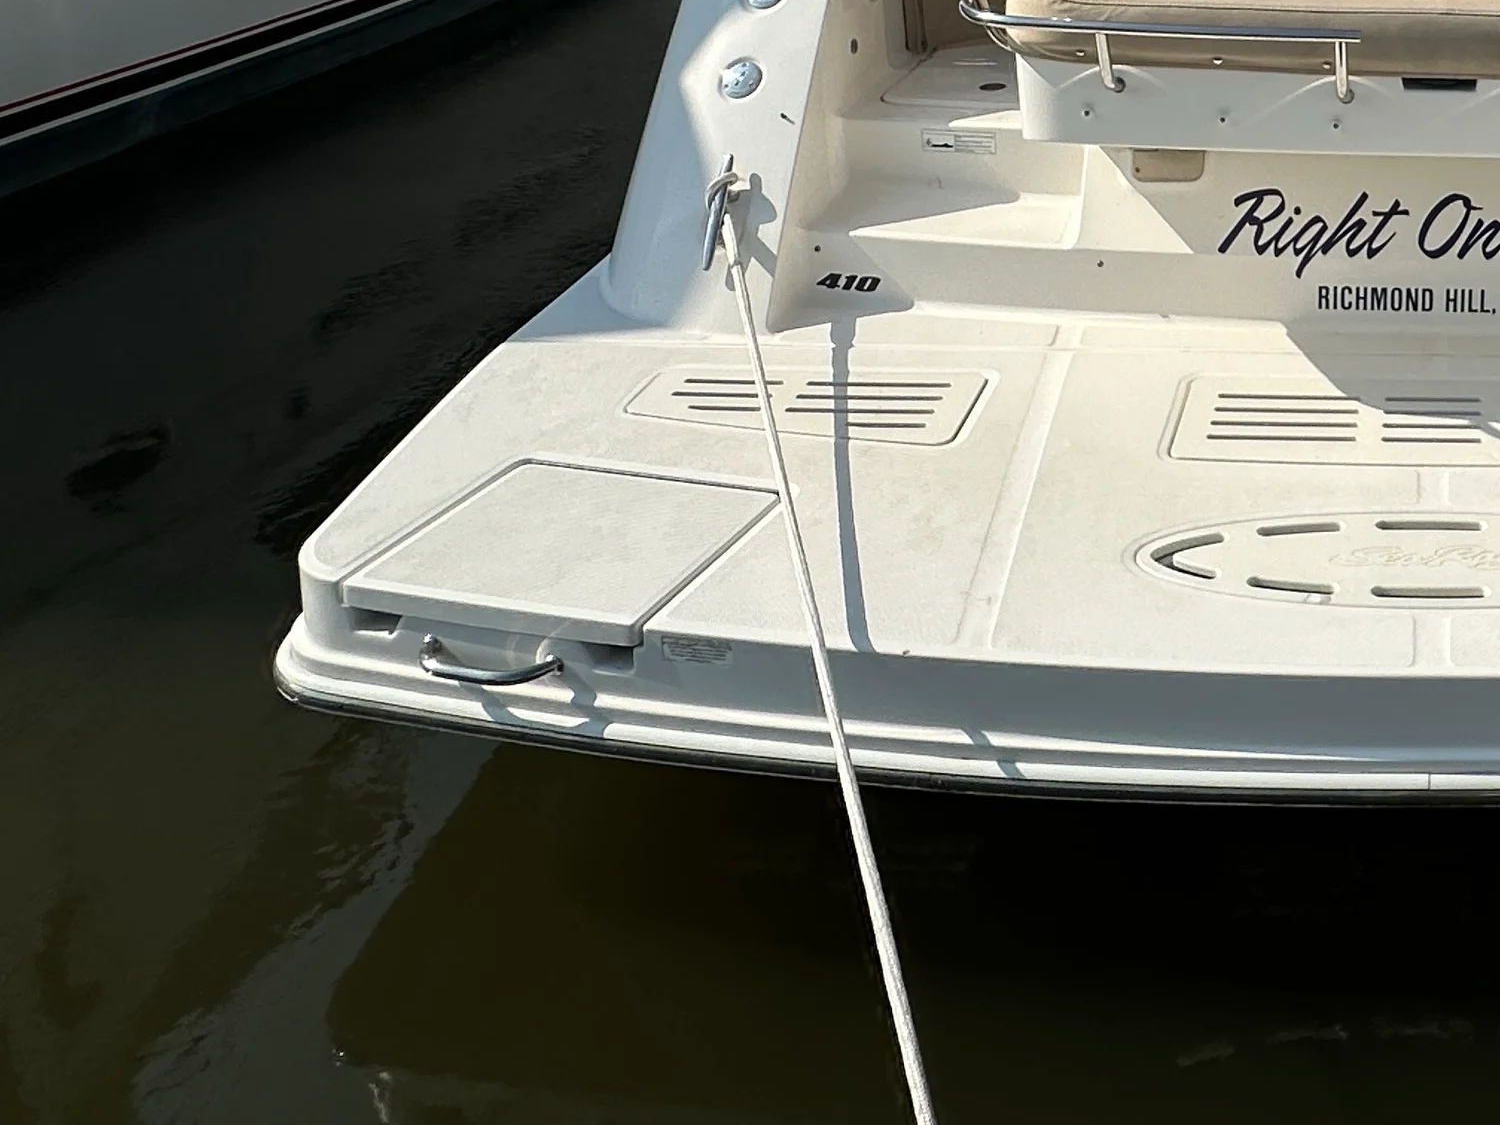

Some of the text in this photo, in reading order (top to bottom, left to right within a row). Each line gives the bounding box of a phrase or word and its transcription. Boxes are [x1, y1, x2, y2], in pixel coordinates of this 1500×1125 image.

[1217, 187, 1410, 278] Right
[816, 272, 881, 292] 410
[1317, 285, 1434, 312] RICHMOND
[1445, 287, 1497, 315] HILL,
